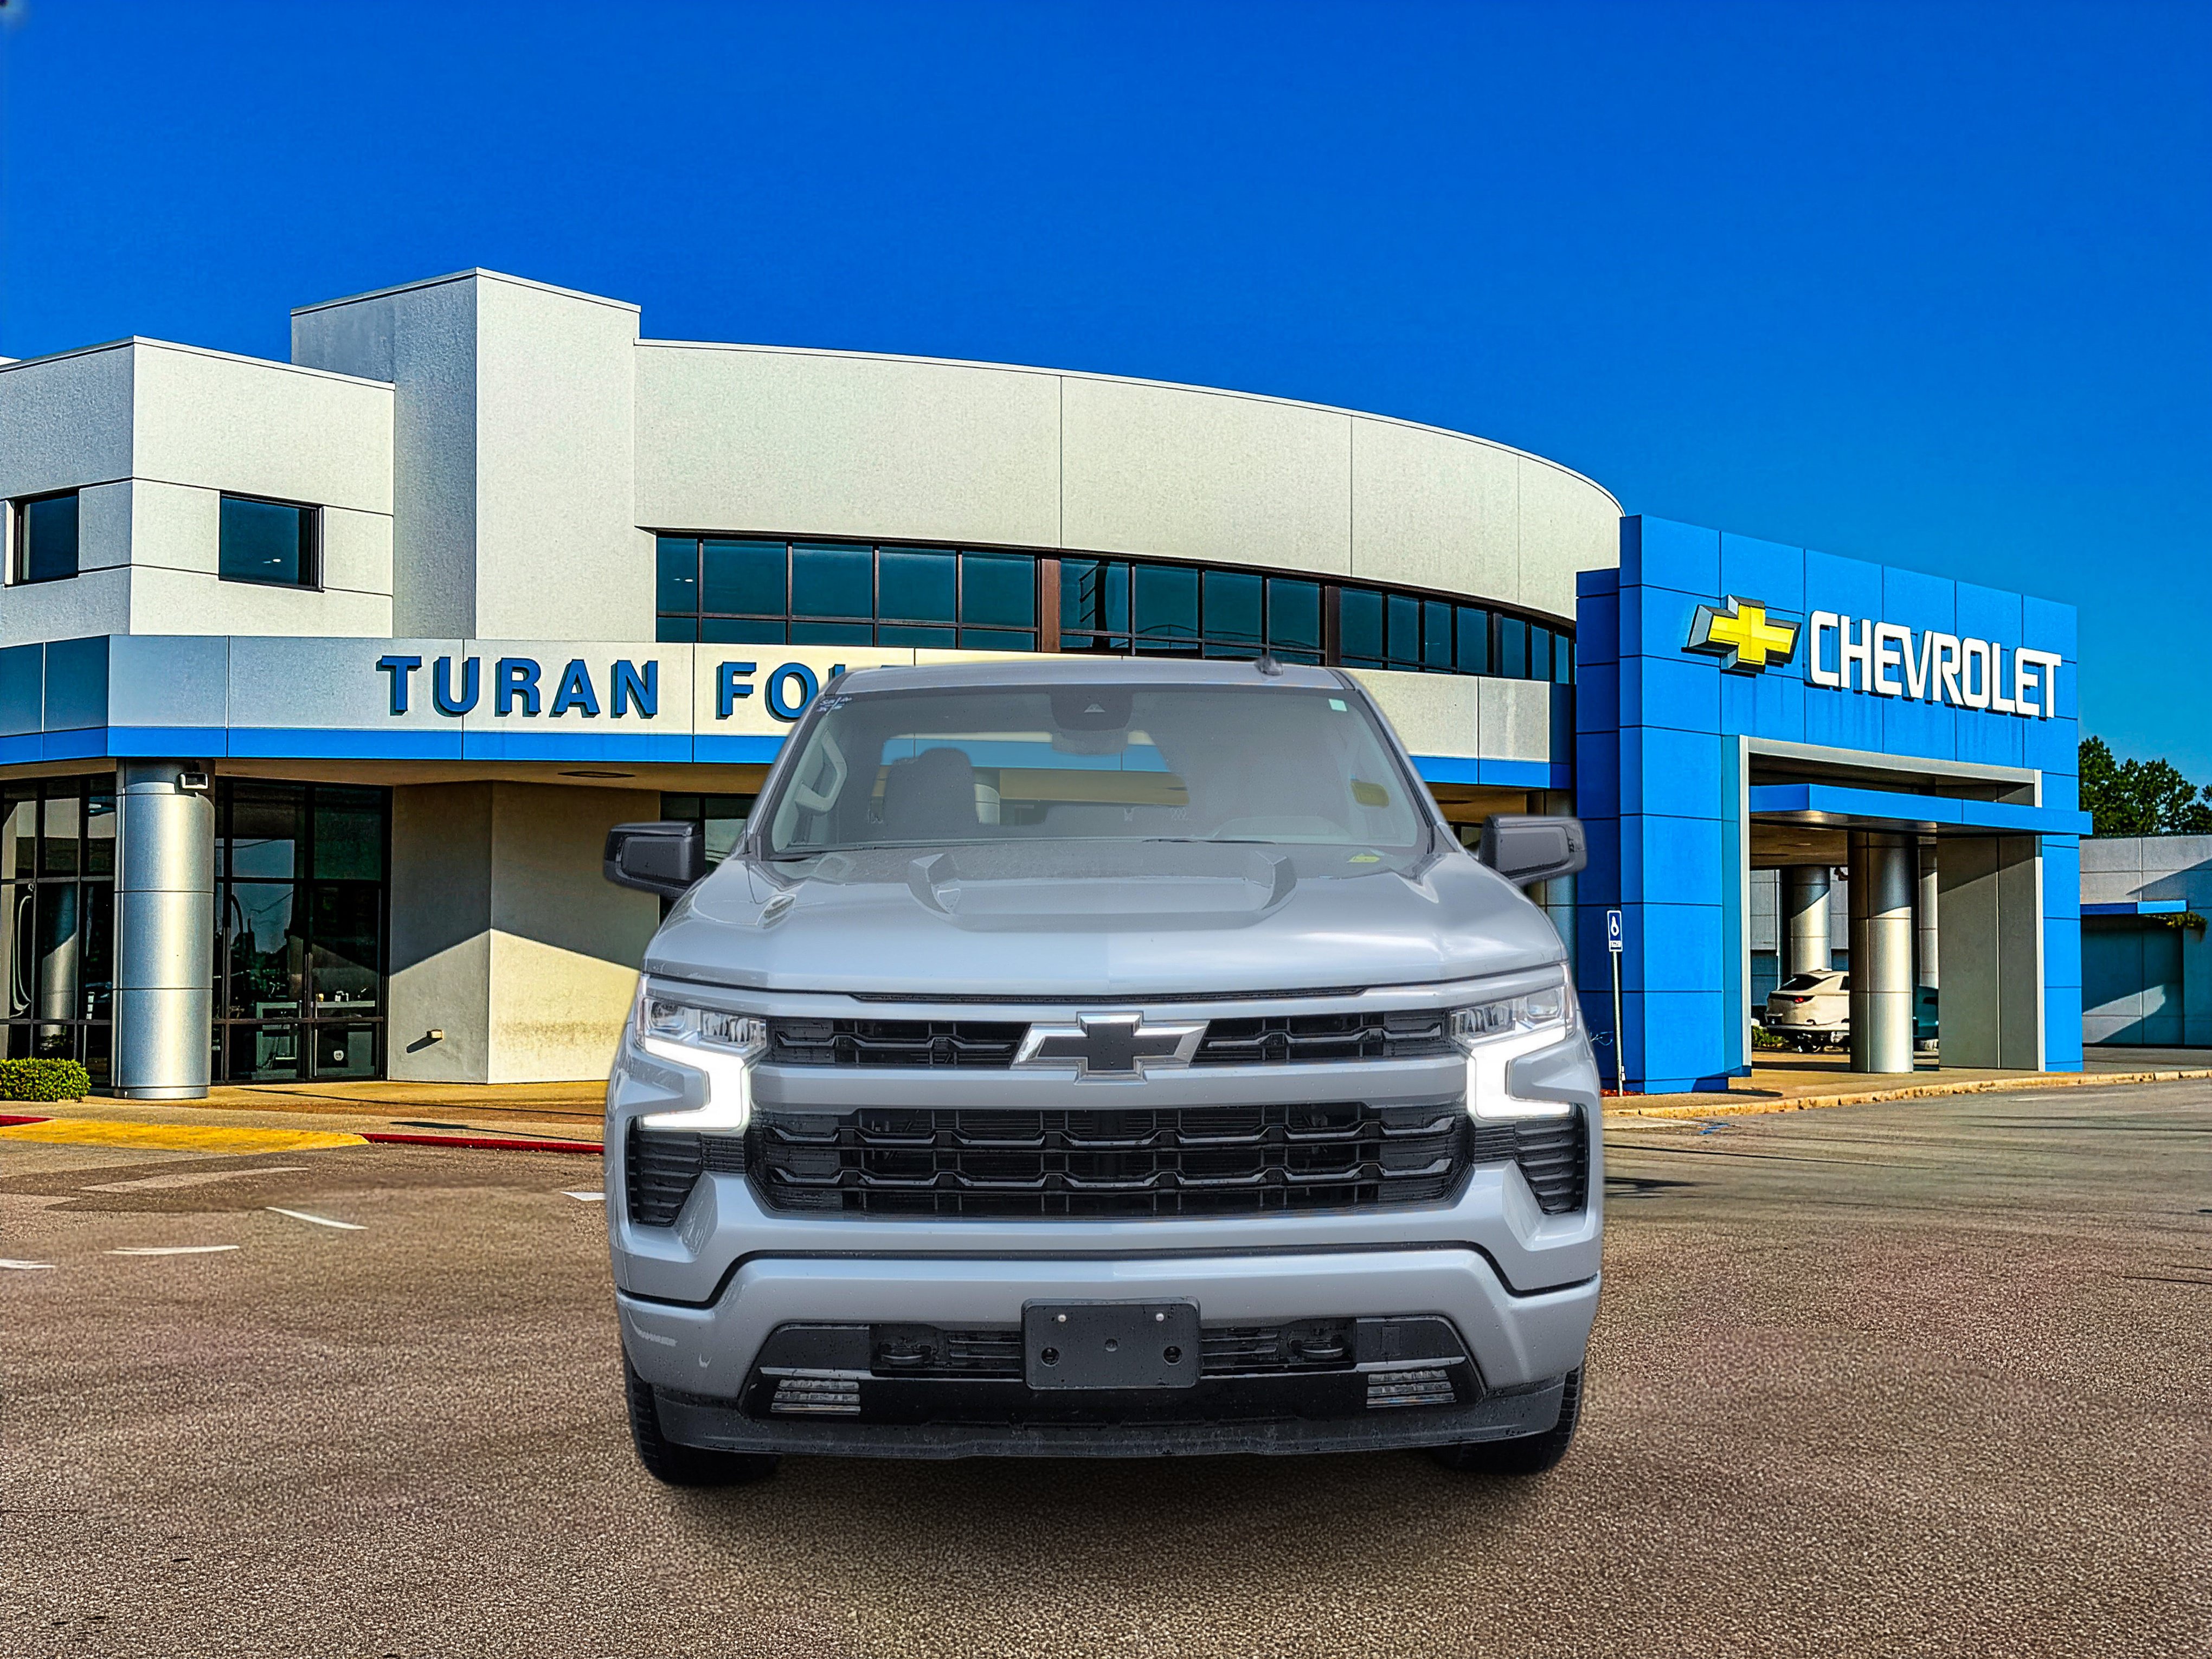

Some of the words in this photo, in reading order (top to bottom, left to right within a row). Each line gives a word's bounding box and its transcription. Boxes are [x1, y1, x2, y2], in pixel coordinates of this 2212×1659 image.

[376, 655, 658, 719] TURAN
[716, 661, 846, 723] FO
[1809, 610, 2062, 718] CHEVROLET
